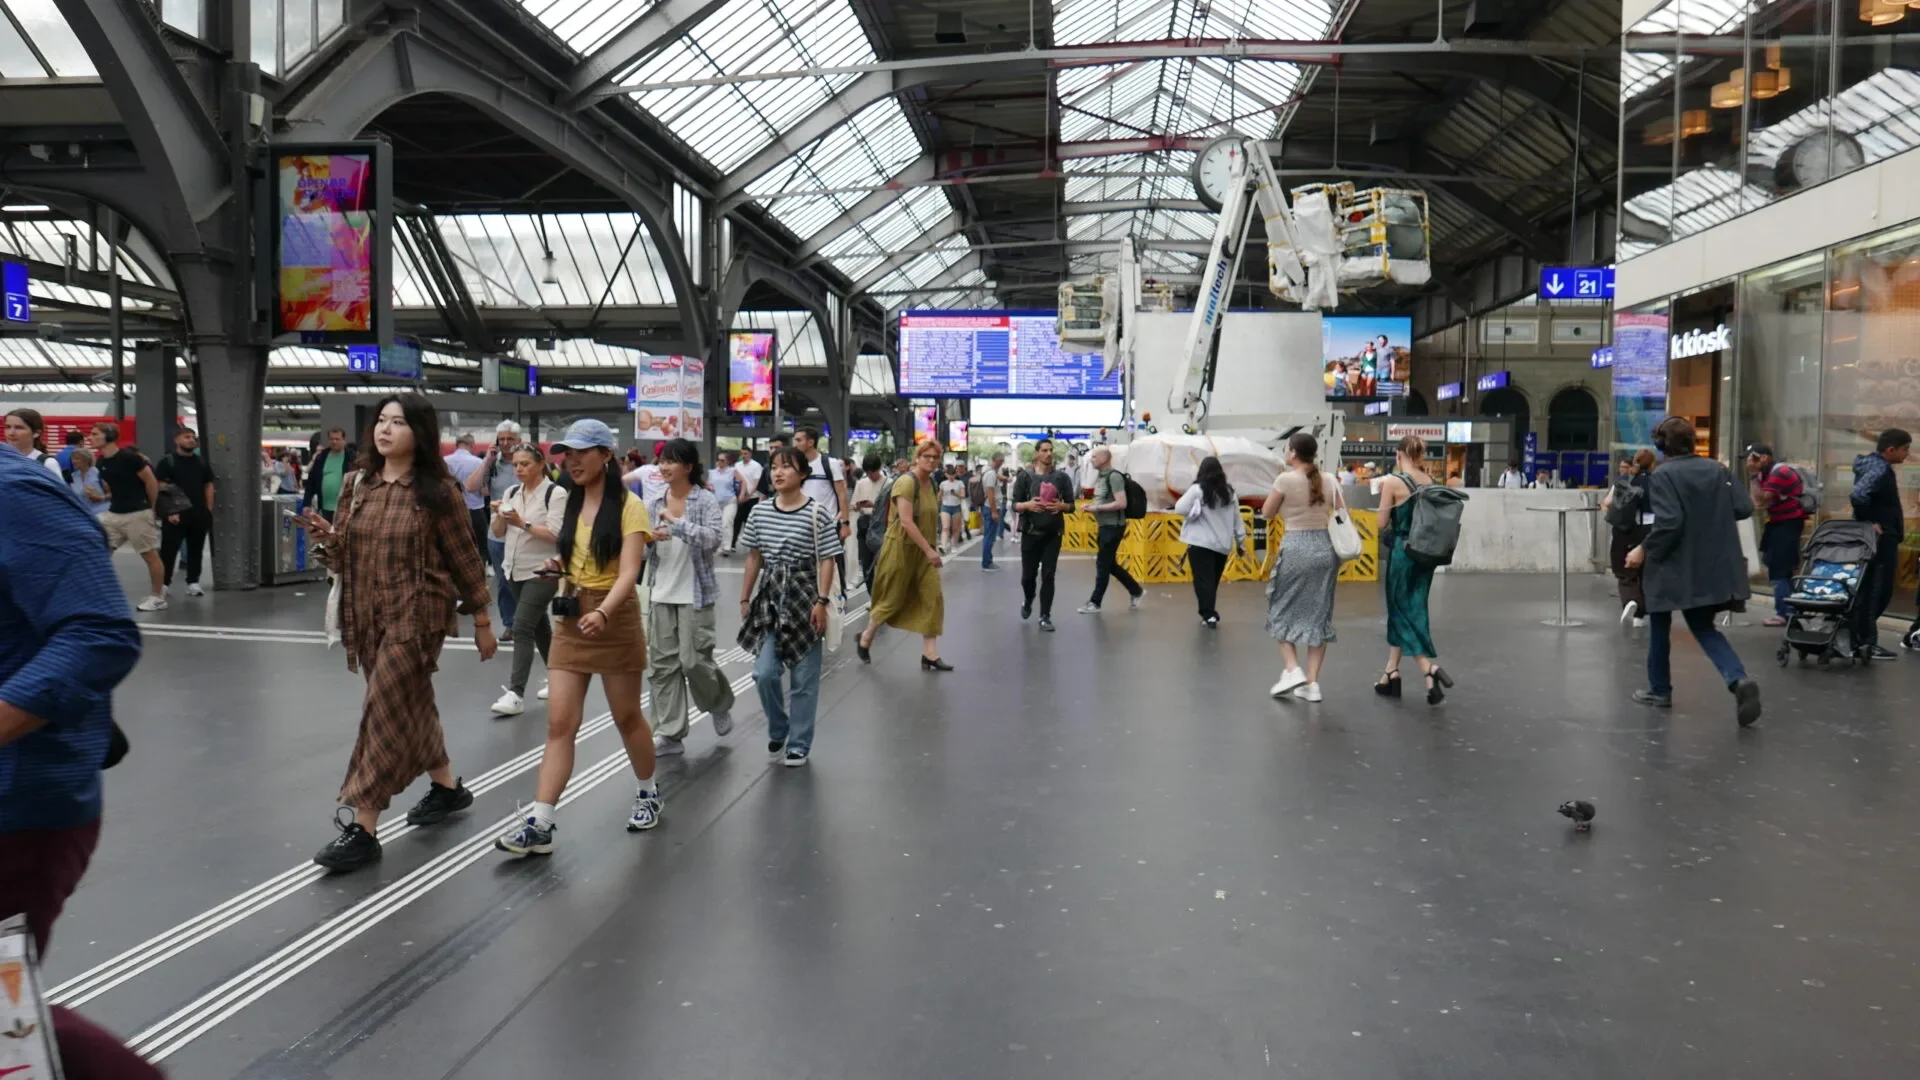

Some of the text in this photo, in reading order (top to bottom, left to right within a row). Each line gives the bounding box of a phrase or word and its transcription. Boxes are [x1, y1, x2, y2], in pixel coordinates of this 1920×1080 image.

[1205, 260, 1227, 325] maltech
[1579, 280, 1596, 293] 21
[13, 303, 23, 317] 7
